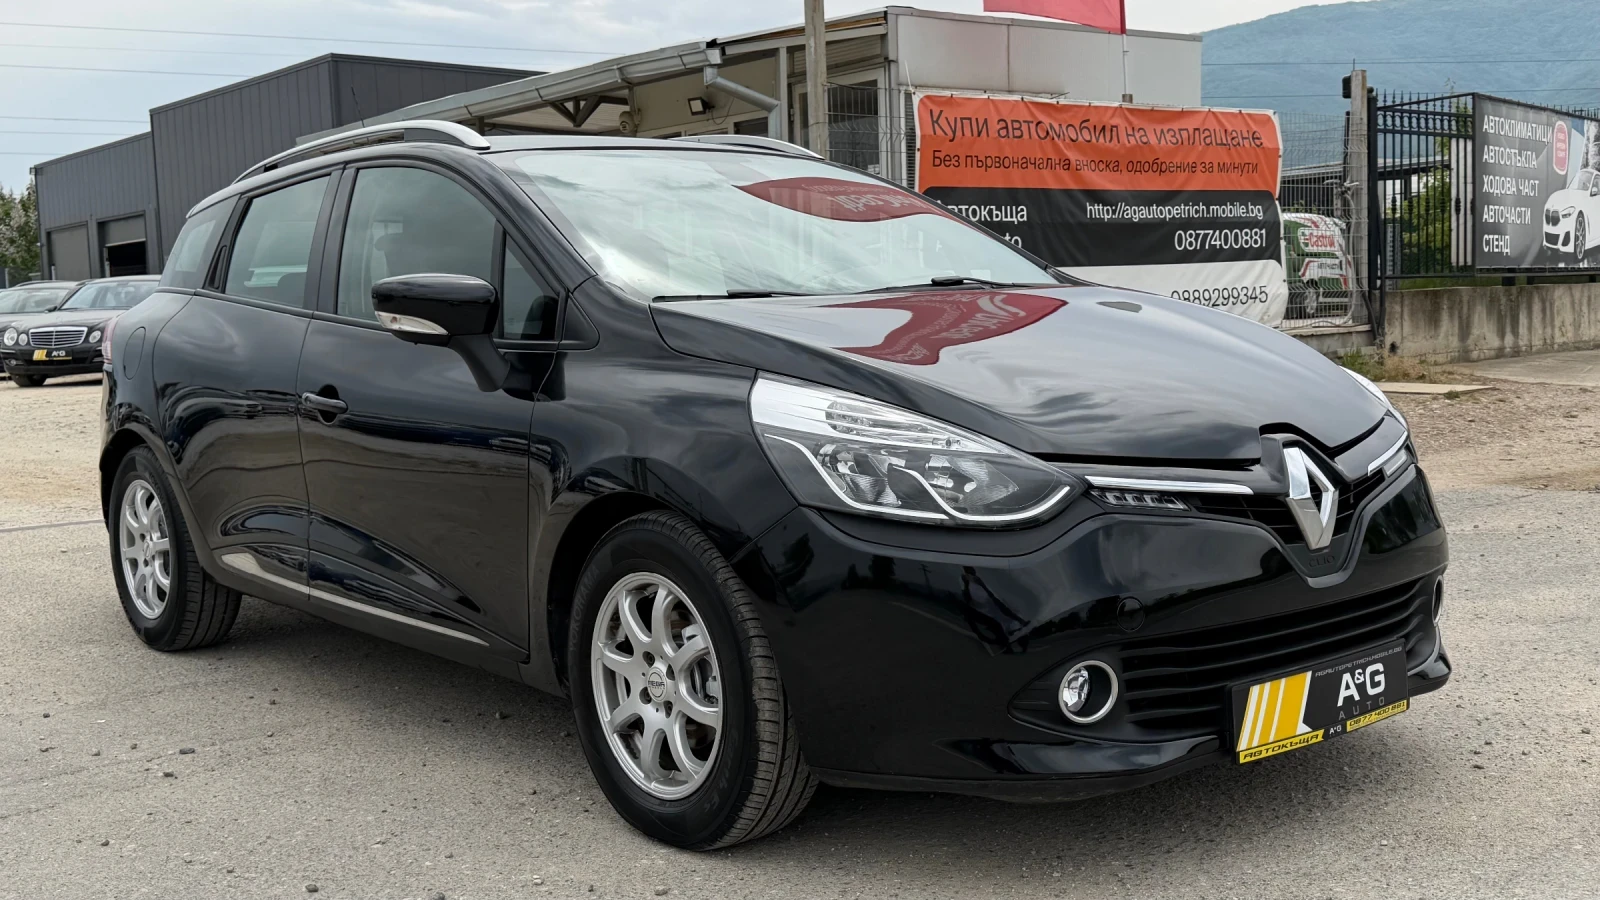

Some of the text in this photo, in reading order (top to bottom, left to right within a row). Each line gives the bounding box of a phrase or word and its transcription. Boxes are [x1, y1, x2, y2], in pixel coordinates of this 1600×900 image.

[929, 108, 1263, 151] Купи автомобил на изплащане
[1482, 115, 1553, 145] АВТОКЛИМАТИЦИ
[932, 150, 1258, 177] Без първоначална вноска, одобрение за минути
[1482, 145, 1538, 169] АВТОСТЪКЛА
[1482, 175, 1540, 198] ХОДОВА ЧАСТ
[936, 200, 1028, 225] токъща
[1086, 202, 1263, 222] http://agautopetrich.mobile.bg
[1482, 204, 1531, 225] АВТОЧАСТИ
[1174, 228, 1267, 251] 0877400881
[1482, 234, 1511, 255] СТЕНД
[1308, 555, 1335, 568] CLIO
[1337, 662, 1386, 707] A&G
[1349, 713, 1374, 727] 0877
[1374, 706, 1391, 720] 400
[1392, 701, 1406, 712] 881
[1243, 733, 1319, 760] АВТОКЪЩА
